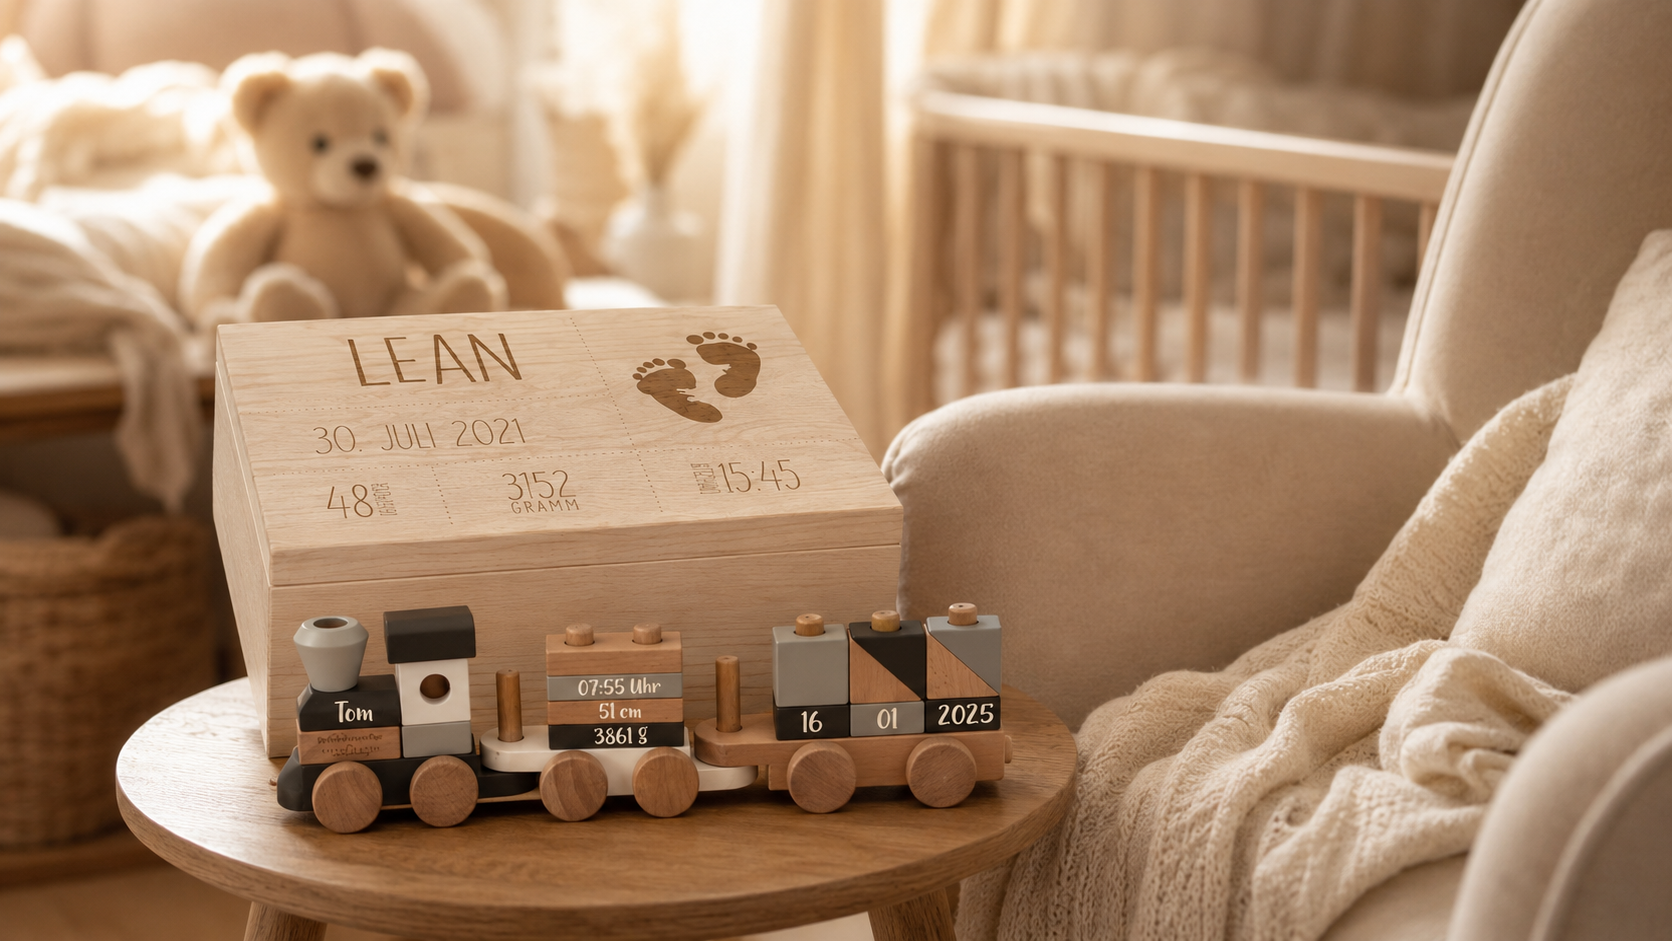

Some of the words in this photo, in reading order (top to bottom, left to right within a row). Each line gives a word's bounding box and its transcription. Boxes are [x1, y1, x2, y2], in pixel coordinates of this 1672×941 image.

[347, 332, 522, 386] LEAN
[313, 425, 362, 454] 30.
[381, 422, 436, 451] JULI
[451, 418, 526, 447] 2021
[502, 470, 577, 500] 3152
[718, 459, 800, 493] 15:45
[327, 484, 373, 519] 48
[511, 499, 579, 514] GRAMM
[578, 678, 625, 696] 07:55
[630, 677, 661, 694] Uhr
[334, 700, 373, 723] Tom
[599, 702, 615, 719] 51
[620, 707, 641, 719] cm
[801, 710, 823, 733] 16
[876, 707, 898, 730] 01
[937, 703, 994, 726] 2025
[594, 726, 633, 745] 3861
[638, 726, 648, 745] g
